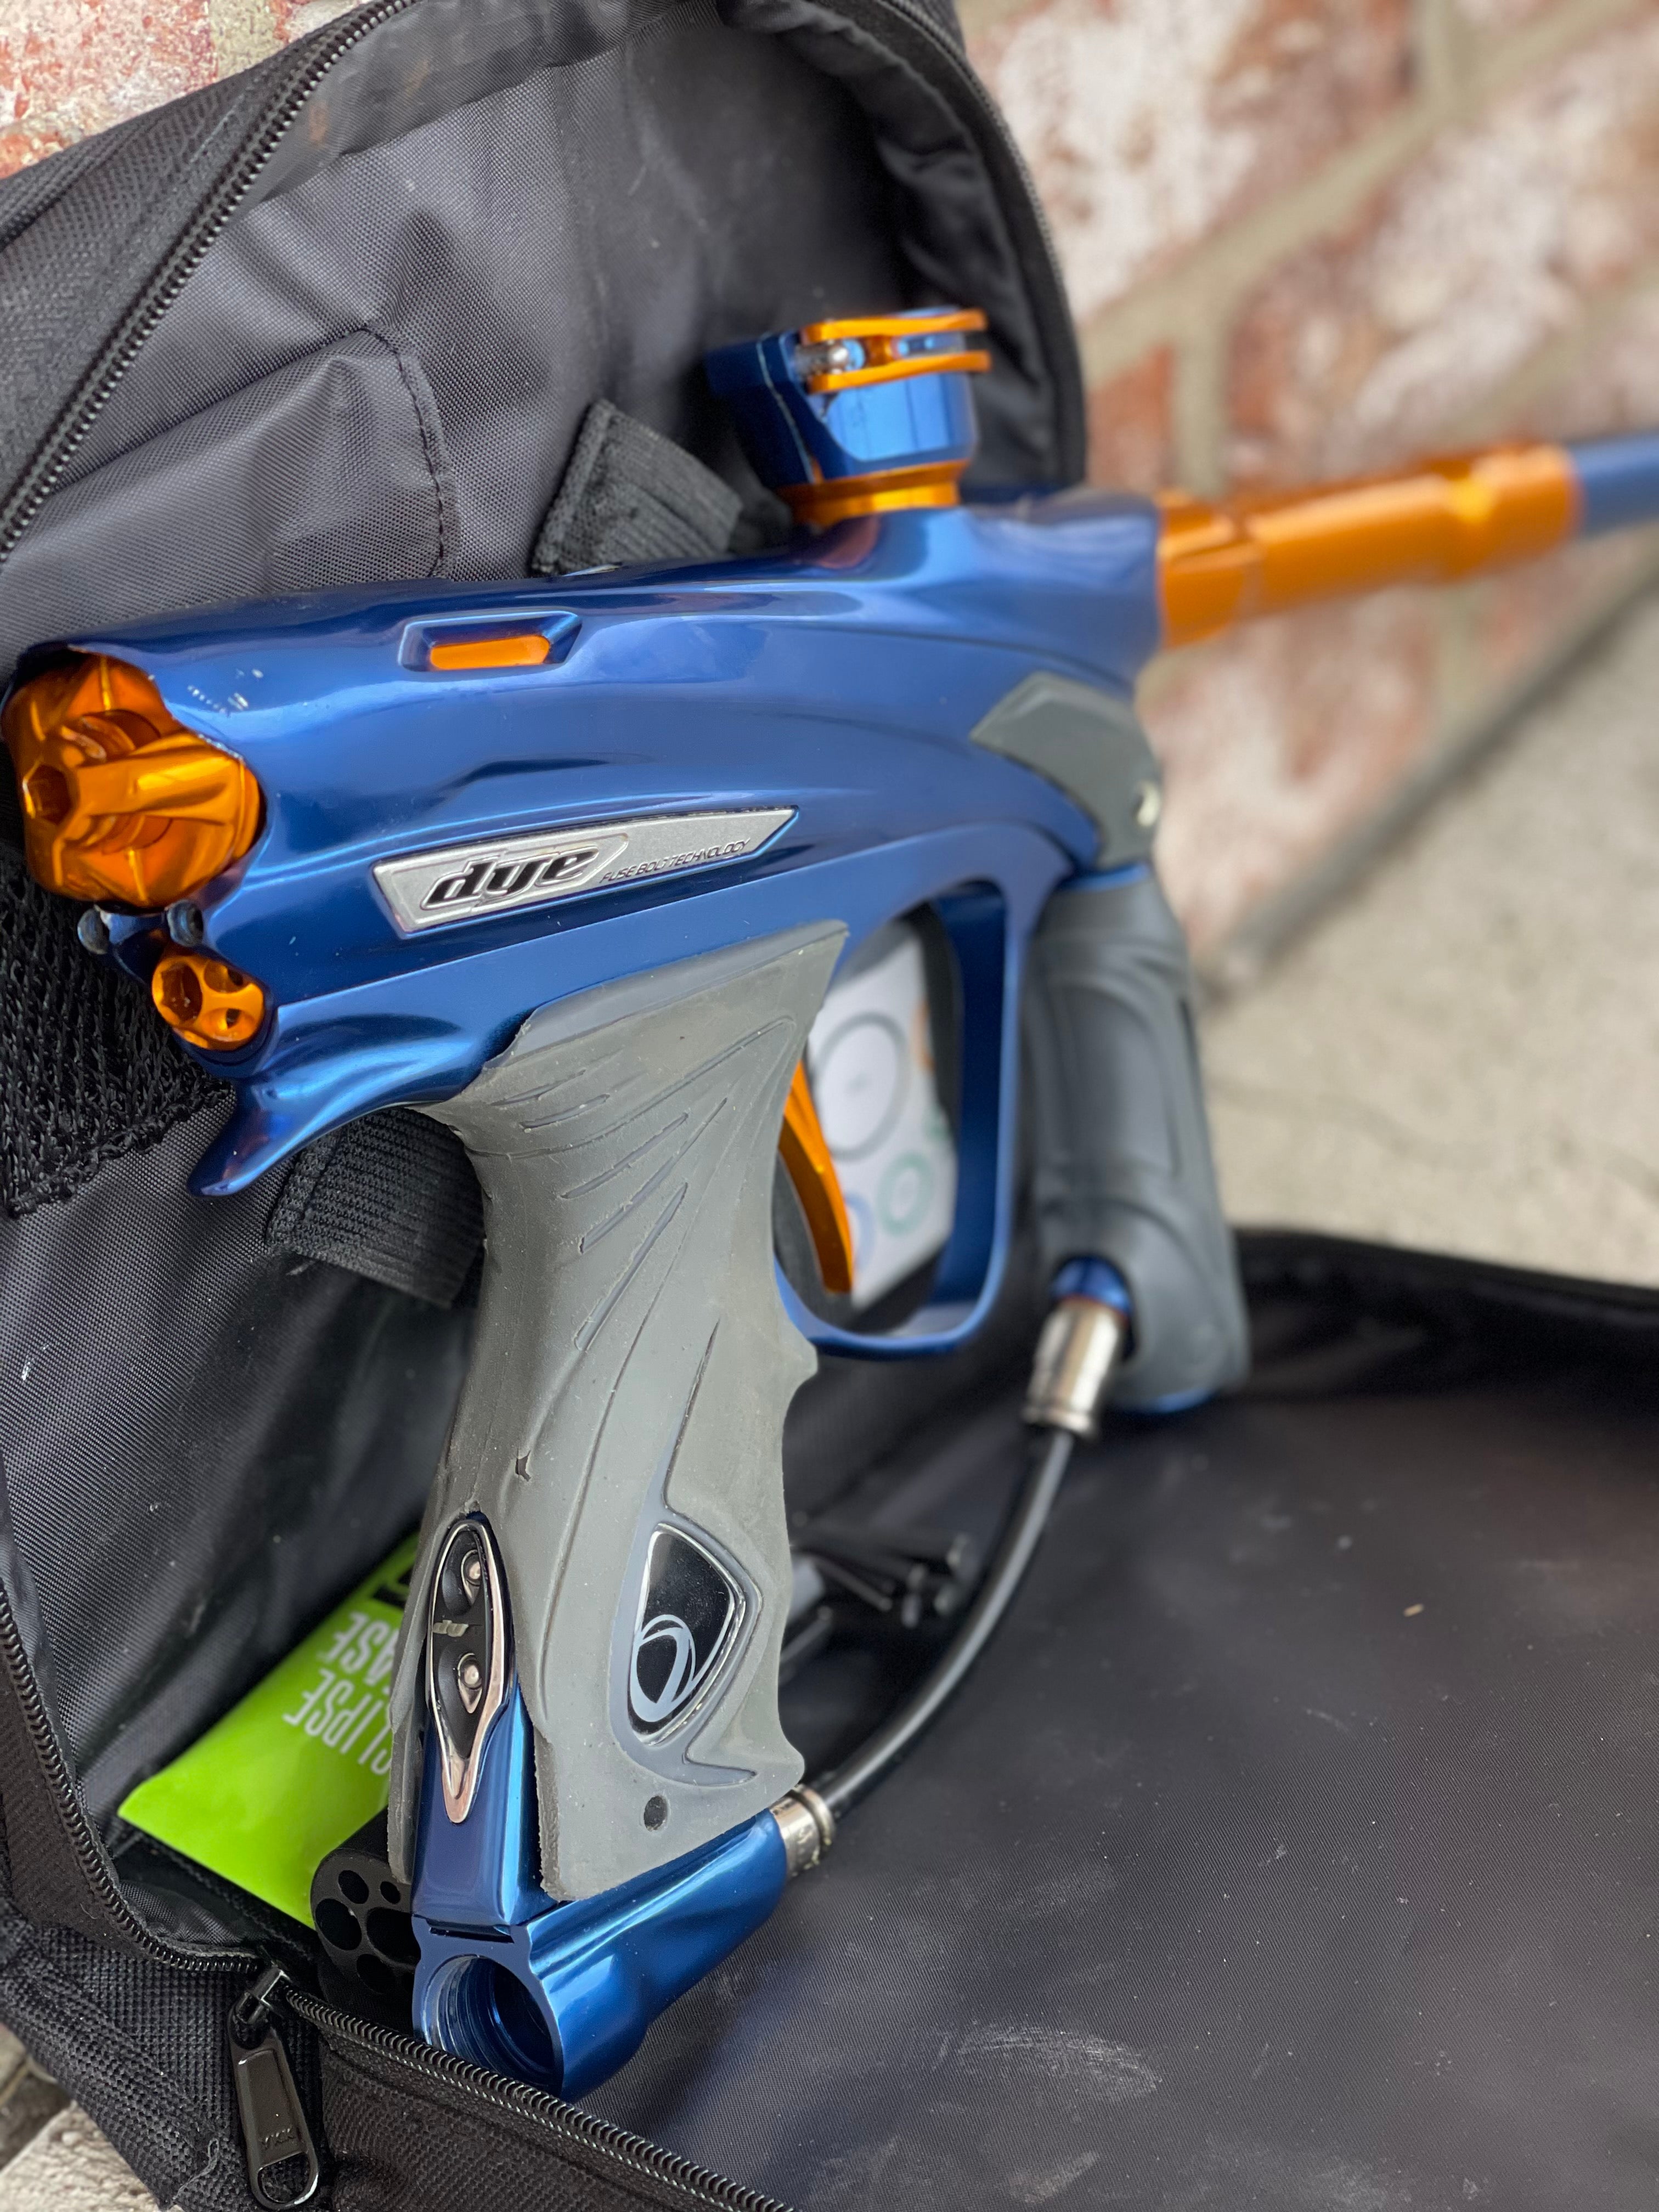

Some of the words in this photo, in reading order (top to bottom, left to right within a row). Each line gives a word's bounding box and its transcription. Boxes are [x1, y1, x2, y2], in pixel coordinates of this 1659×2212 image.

[425, 849, 599, 906] dye
[599, 866, 637, 884] FUSE
[635, 859, 669, 876] BOLT
[669, 837, 751, 866] TECHNOLOGY
